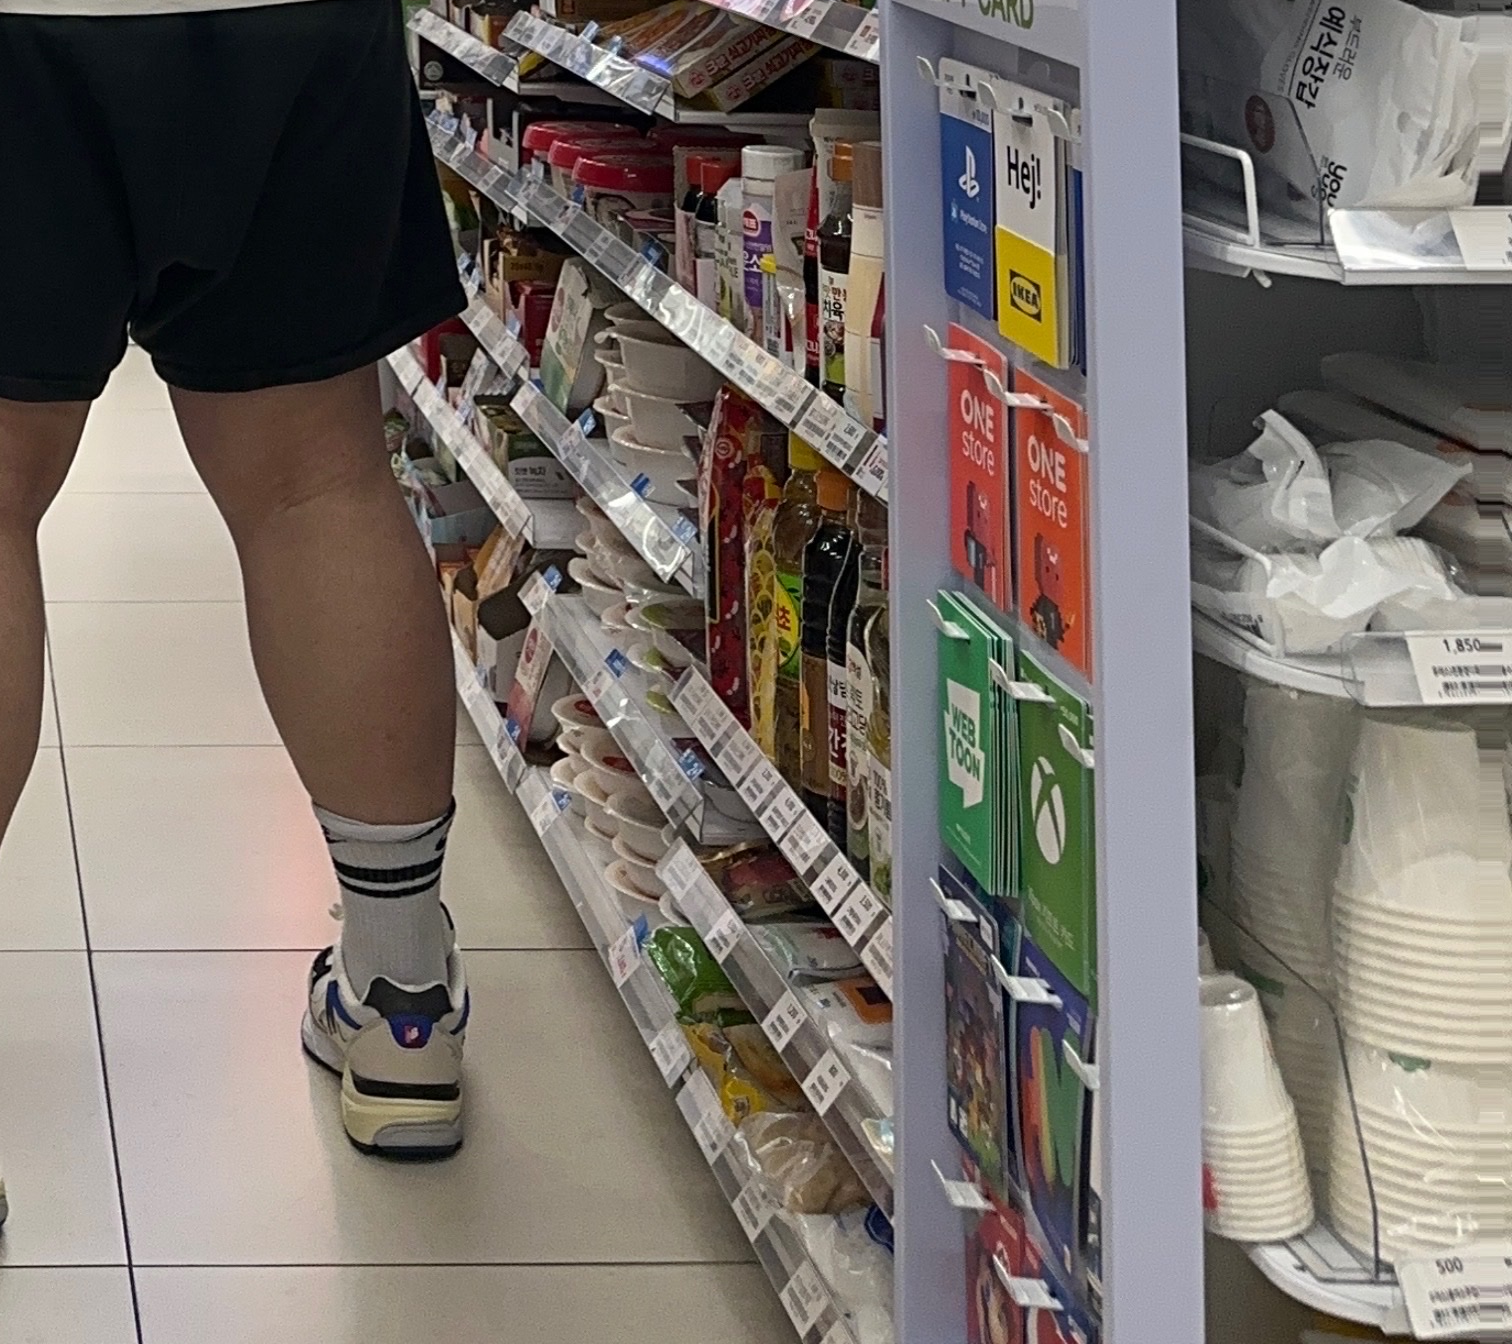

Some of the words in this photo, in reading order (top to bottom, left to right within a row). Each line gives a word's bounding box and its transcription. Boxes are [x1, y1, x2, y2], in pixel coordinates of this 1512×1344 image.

[1295, 5, 1346, 110] 예식장갑
[1005, 145, 1042, 211] Hej!
[1011, 278, 1040, 311] IKEA
[959, 388, 995, 443] ONE
[961, 431, 996, 477] store
[1026, 434, 1067, 494] ONE
[1028, 478, 1069, 530] store
[950, 702, 977, 743] WEB
[948, 727, 982, 783] TOON
[1434, 1255, 1464, 1276] 500
